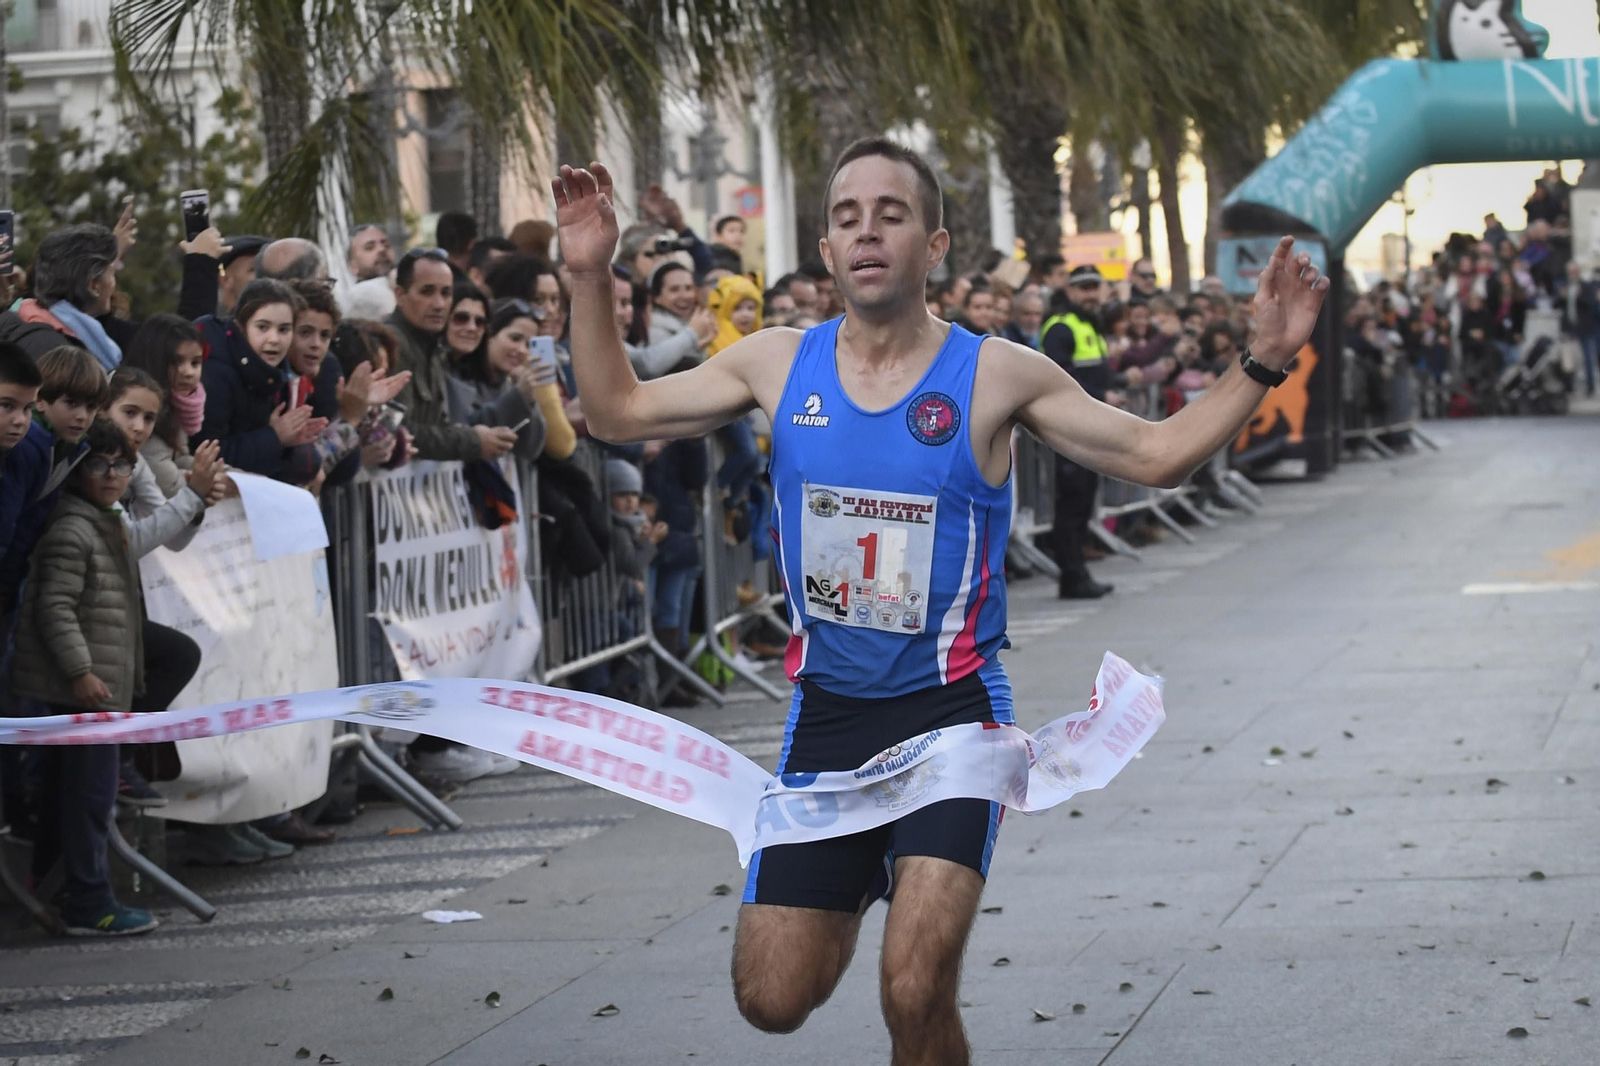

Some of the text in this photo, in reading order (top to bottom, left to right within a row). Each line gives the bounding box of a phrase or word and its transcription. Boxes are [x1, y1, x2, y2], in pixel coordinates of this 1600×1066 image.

[792, 413, 830, 427] VIATOR
[377, 468, 472, 545] DONA SANG
[842, 496, 933, 513] III SAN SILVESTRE
[854, 506, 923, 520] GADITANA
[856, 531, 878, 580] 1
[377, 555, 431, 626] DONA
[434, 541, 502, 615] MEDULA
[885, 728, 942, 773] POLIDEPORTIVO
